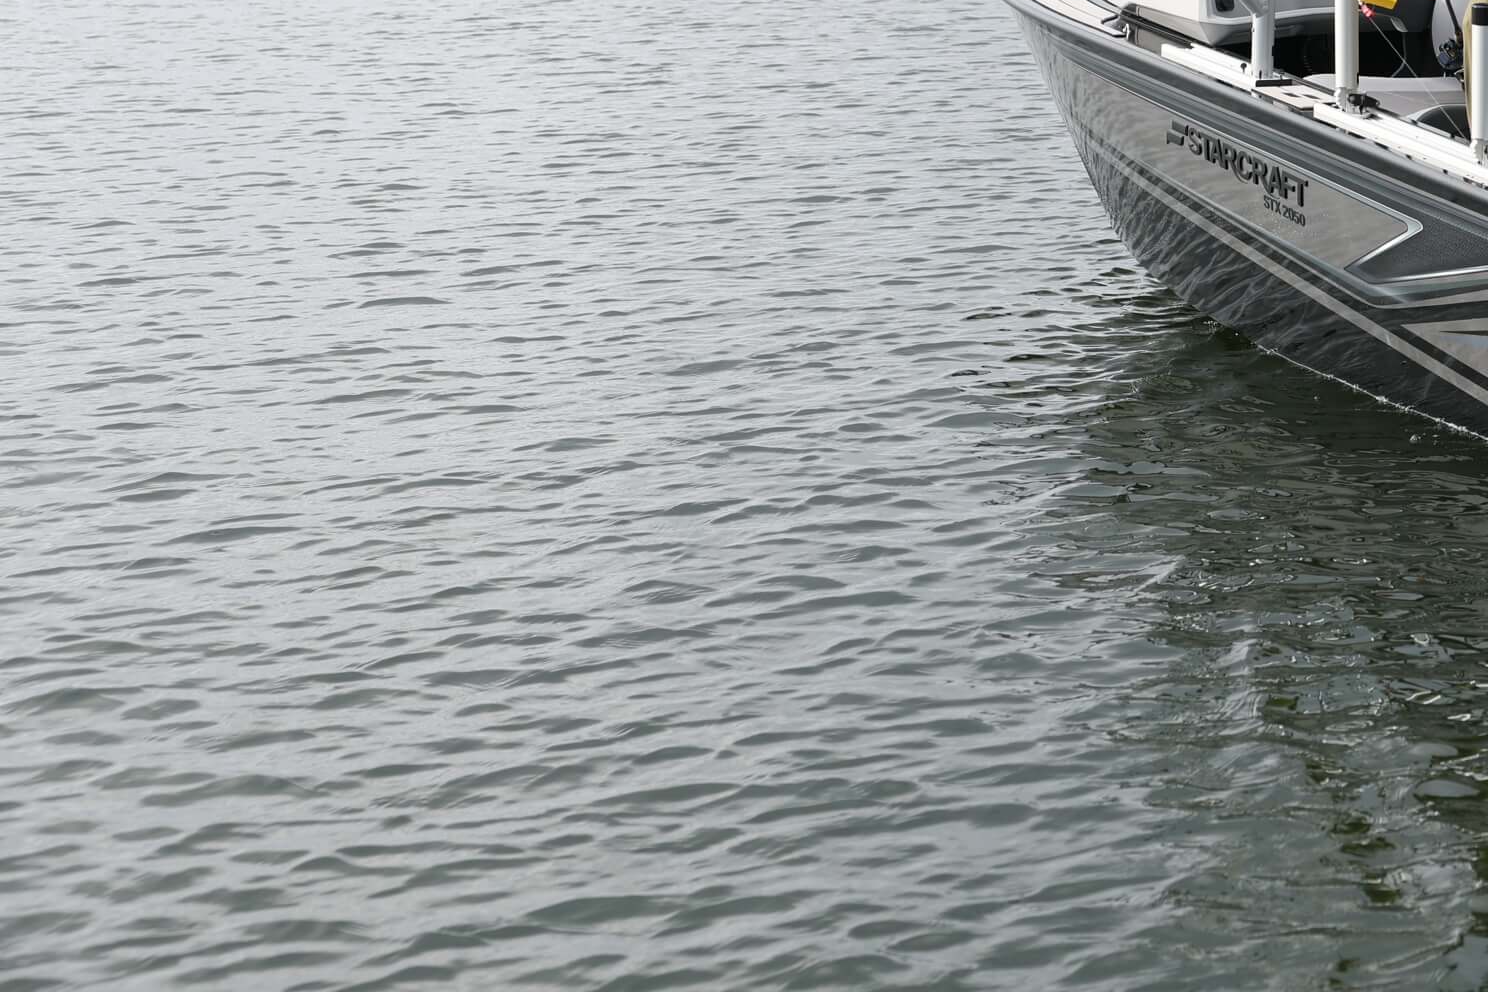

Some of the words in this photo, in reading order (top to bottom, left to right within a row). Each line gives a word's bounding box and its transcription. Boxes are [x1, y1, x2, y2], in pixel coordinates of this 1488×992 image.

[1188, 127, 1309, 208] STARCRAFT
[1264, 194, 1283, 215] STX
[1282, 204, 1306, 227] 2050
